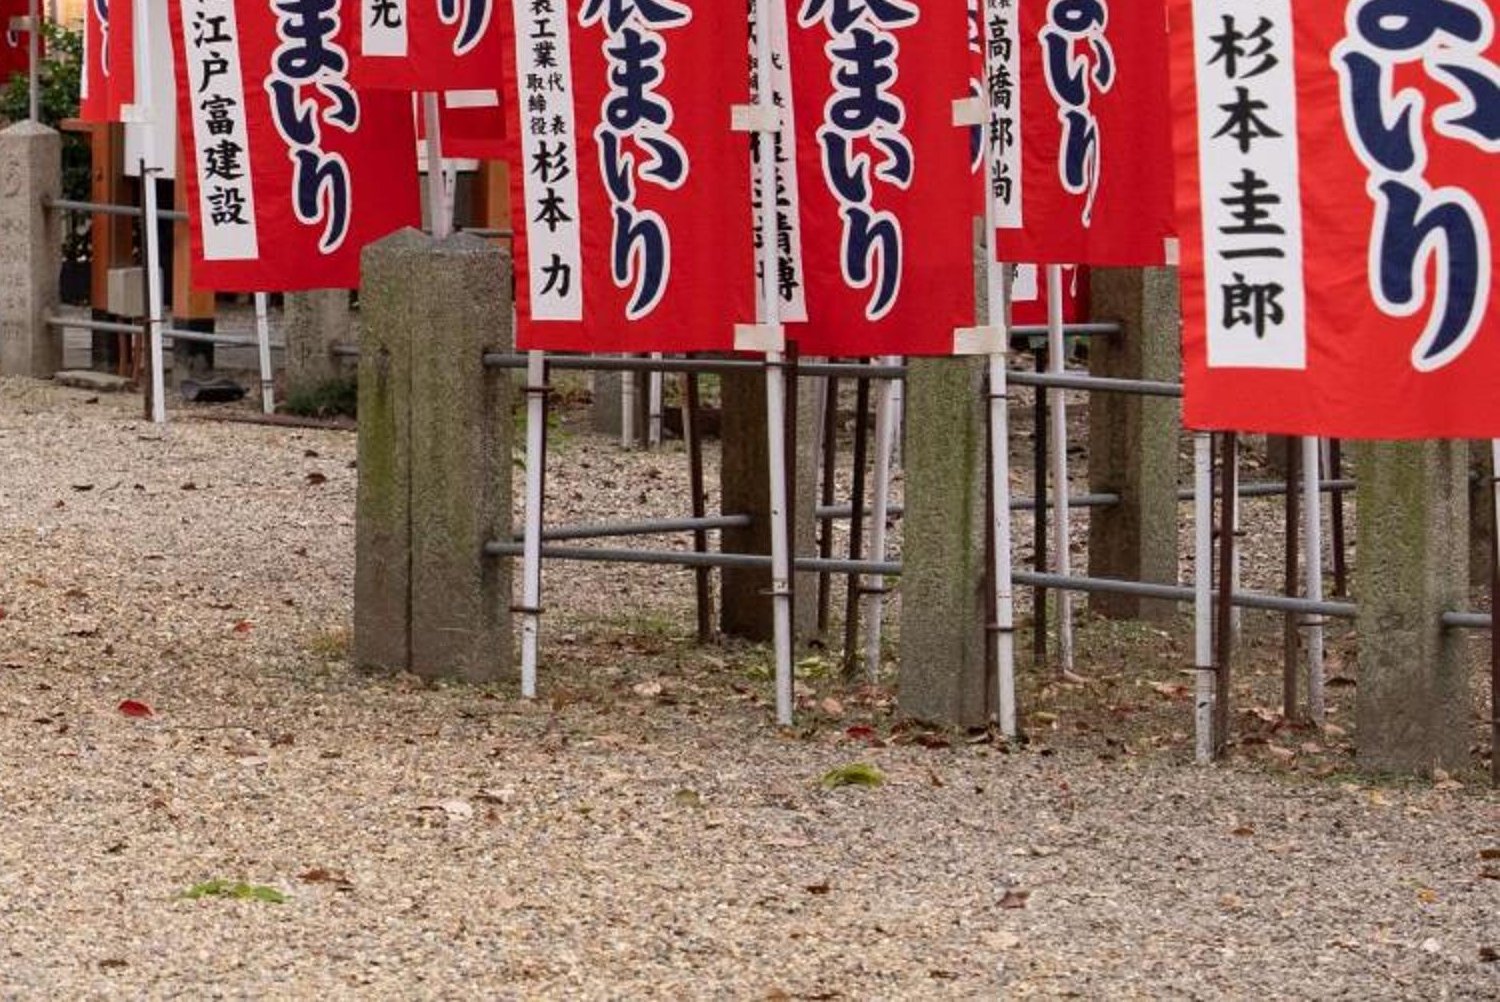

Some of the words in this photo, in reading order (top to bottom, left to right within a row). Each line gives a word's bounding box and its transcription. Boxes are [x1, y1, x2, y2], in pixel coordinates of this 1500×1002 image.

[529, 140, 574, 299] 杉本力
[1207, 13, 1287, 341] 杉本圭一郎
